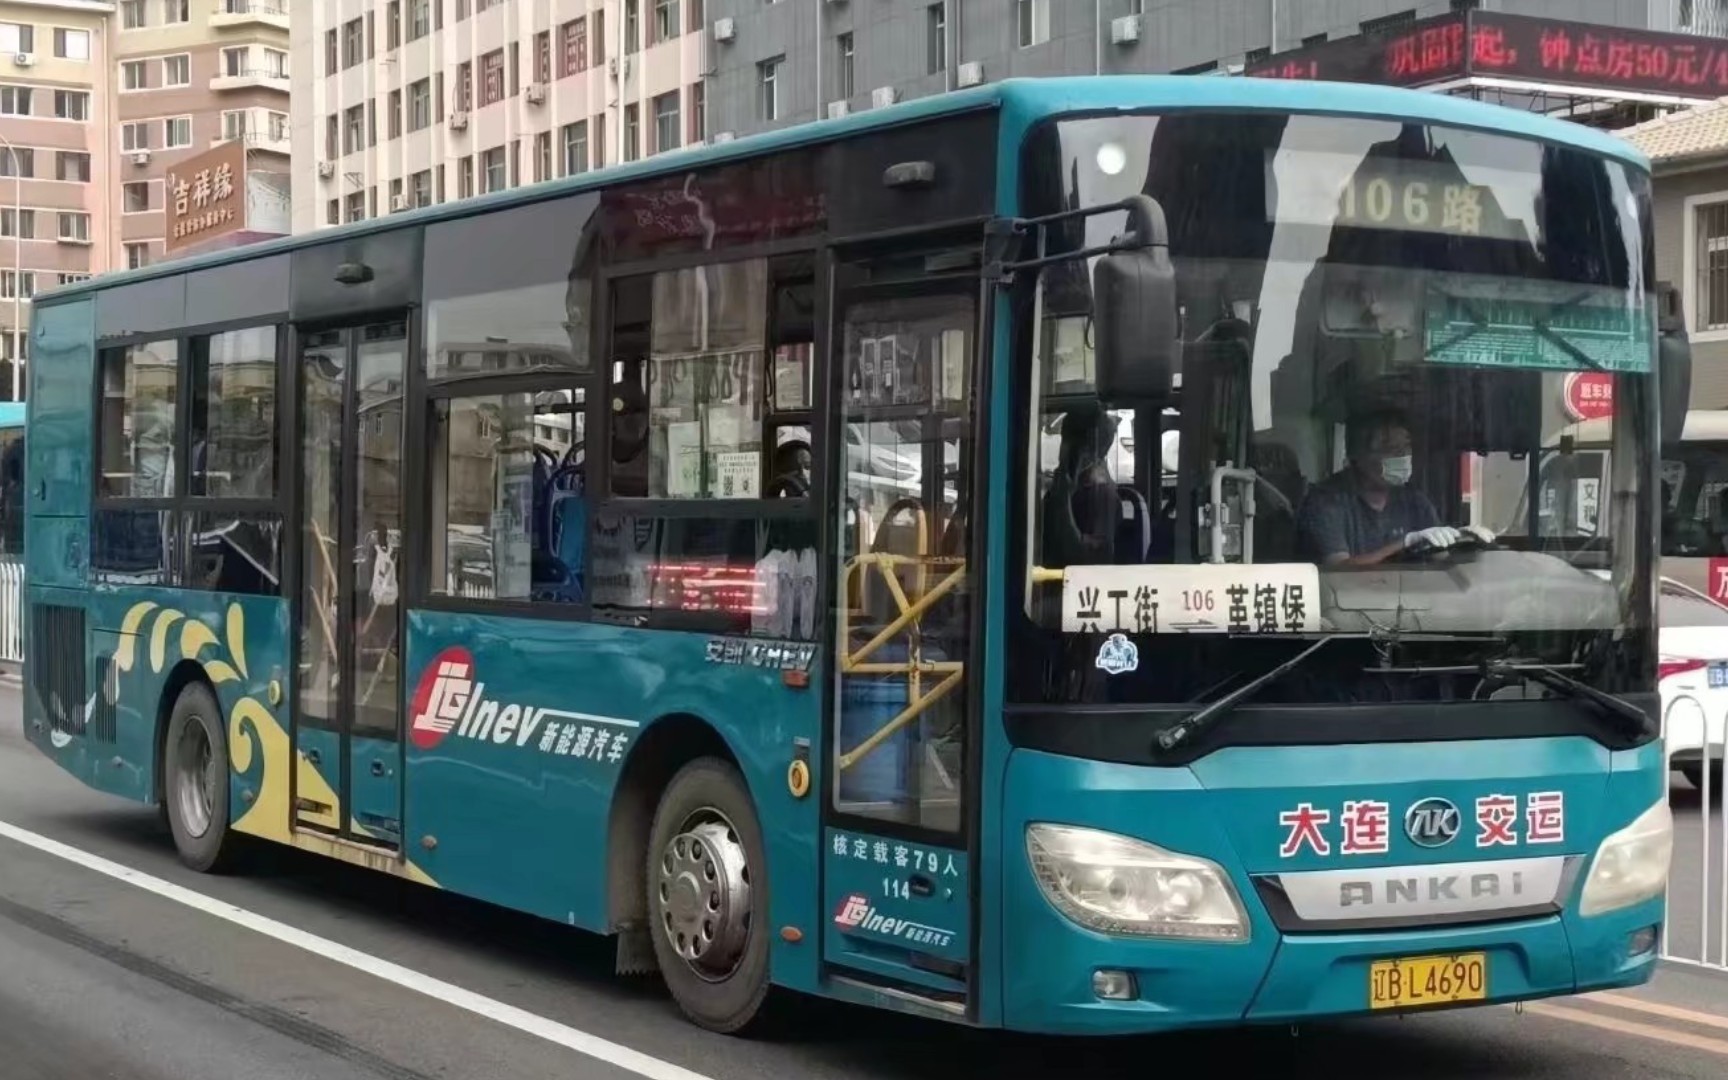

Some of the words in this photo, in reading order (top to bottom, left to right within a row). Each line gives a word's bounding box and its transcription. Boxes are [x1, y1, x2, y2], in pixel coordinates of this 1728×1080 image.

[1342, 177, 1482, 236] 106路
[1077, 584, 1159, 633] 兴工街
[1182, 589, 1215, 612] 106
[539, 721, 629, 764] 新能源汽车
[1280, 801, 1390, 857] 大连
[1476, 791, 1564, 847] 交运
[833, 834, 958, 877] 核定载客79人
[883, 877, 910, 900] 114
